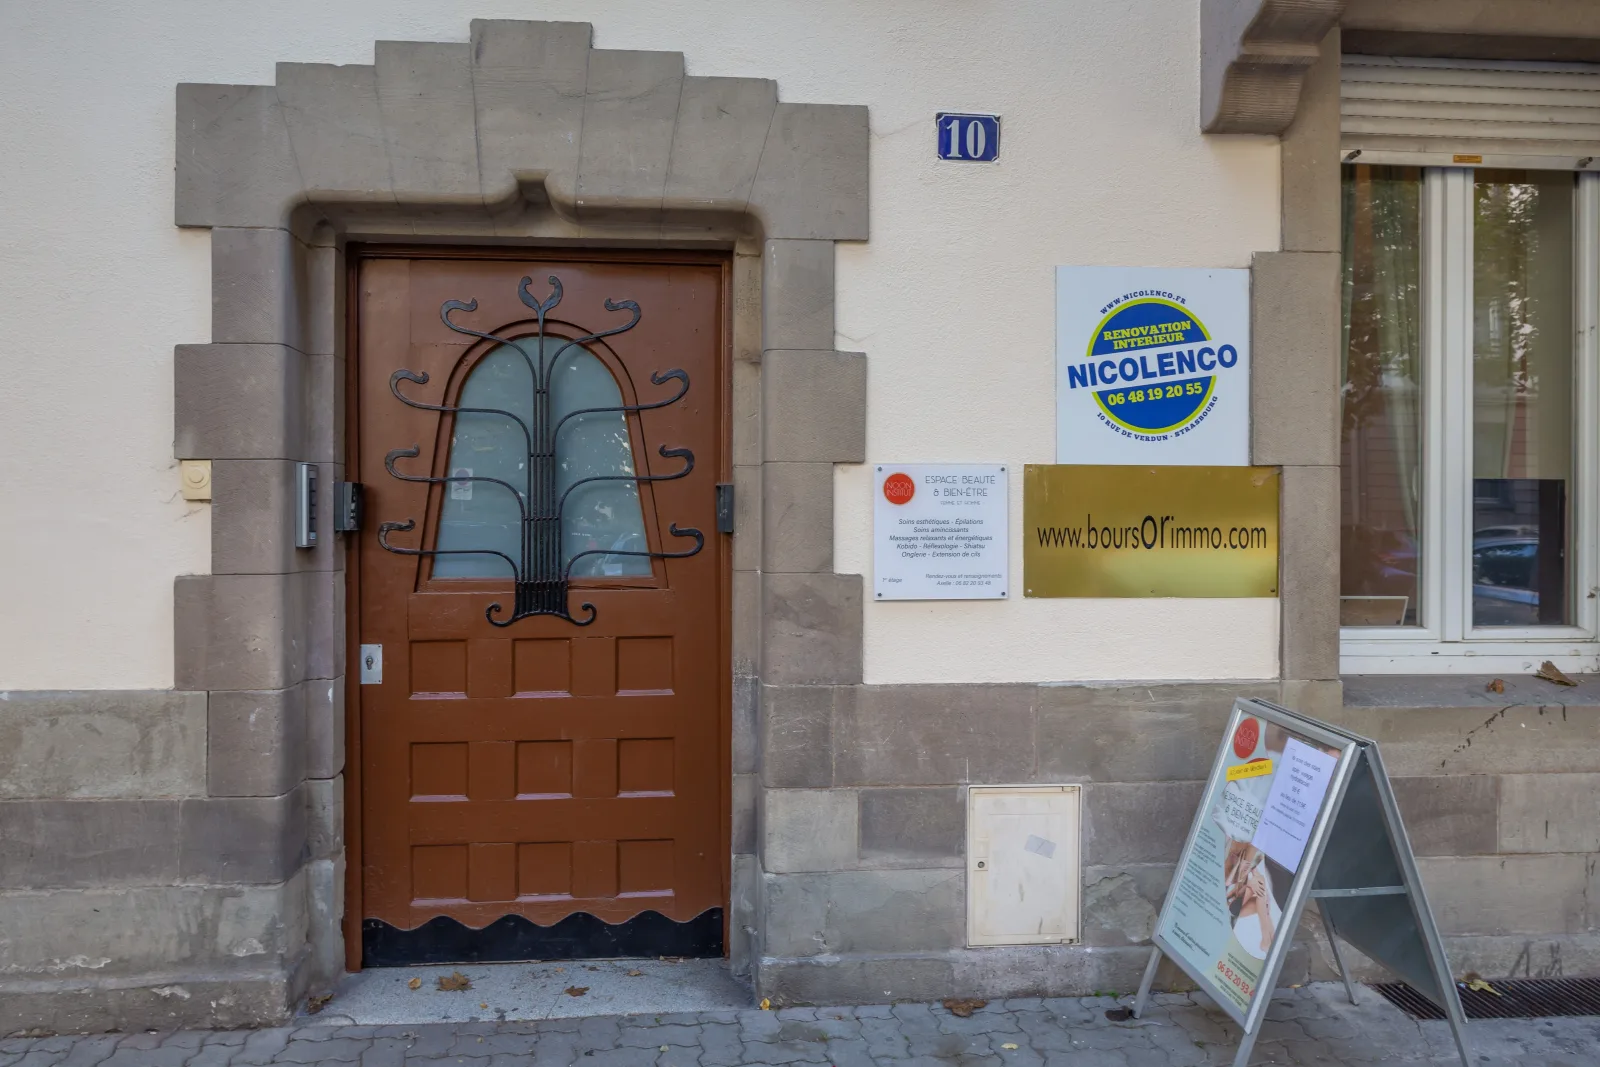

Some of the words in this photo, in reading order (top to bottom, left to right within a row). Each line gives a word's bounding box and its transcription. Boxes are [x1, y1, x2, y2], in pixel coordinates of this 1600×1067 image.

[946, 119, 986, 158] 10
[1100, 290, 1187, 315] WWW.NICOLENCO.FR
[1103, 320, 1192, 341] RENOVATION
[1113, 332, 1185, 350] INTERIEUR
[1067, 344, 1238, 389] NICOLENCO
[1107, 392, 1125, 406] 06
[1128, 389, 1145, 403] 48
[1147, 387, 1163, 400] 19
[1166, 384, 1183, 398] 20
[1186, 382, 1203, 395] 55
[1097, 412, 1106, 421] 10
[1105, 419, 1121, 433] RUE
[1121, 429, 1133, 438] DE
[1134, 434, 1169, 442] VERDUN
[1174, 395, 1218, 438] STRASBOURG
[886, 481, 912, 489] NOON
[925, 475, 958, 484] ESPACE
[962, 474, 996, 484] BEAUTÉ
[886, 488, 912, 497] INSTITUT
[943, 486, 988, 497] BIEN-ÊTRE
[955, 518, 983, 526] Épilations
[1224, 790, 1245, 808] ESPACE
[1244, 802, 1264, 818] BEAUT
[1217, 960, 1226, 973] 06
[1224, 967, 1234, 980] 82
[1232, 973, 1242, 987] 20
[1241, 981, 1250, 994] 93
